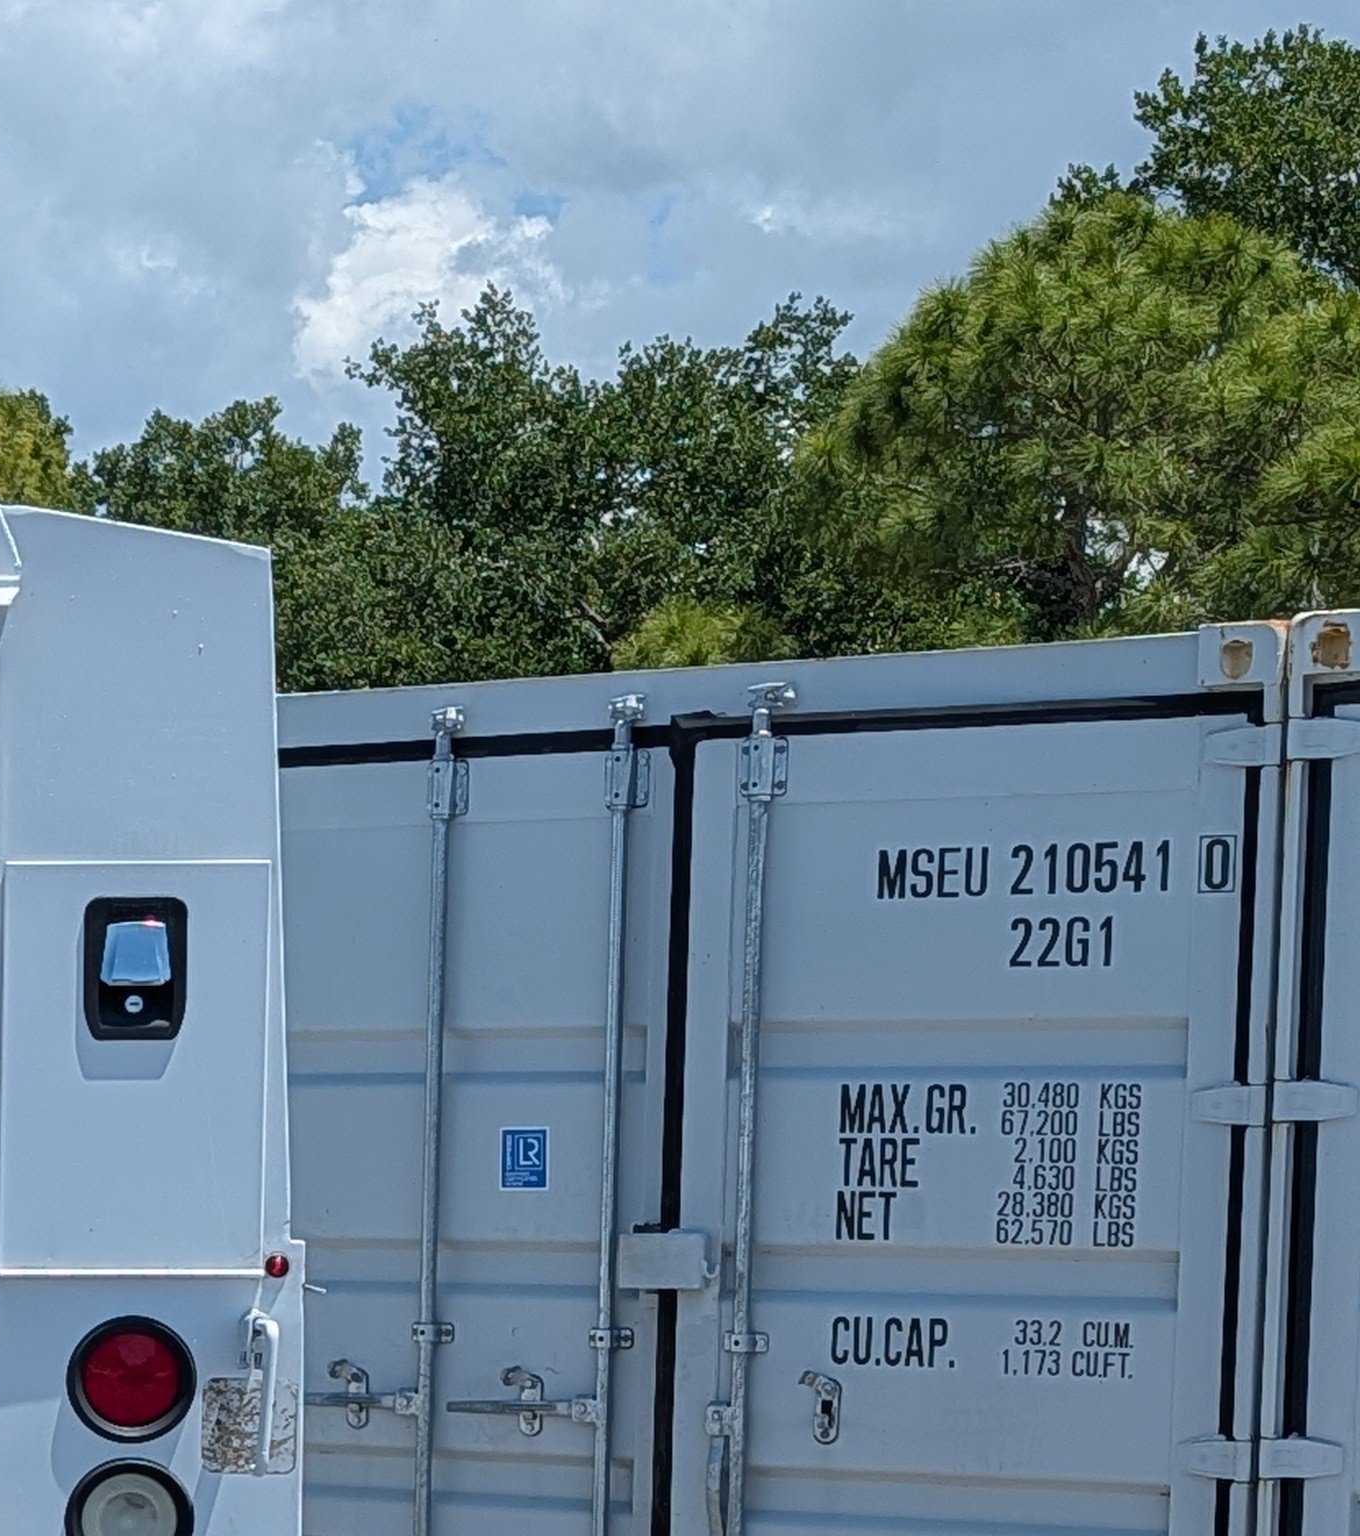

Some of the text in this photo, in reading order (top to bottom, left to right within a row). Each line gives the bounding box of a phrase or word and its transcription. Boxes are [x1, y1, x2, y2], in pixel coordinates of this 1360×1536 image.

[877, 839, 1230, 899] MSEU 210541 0
[1010, 916, 1113, 967] 22G1
[839, 1084, 975, 1134] MAX.GR.
[1100, 1083, 1141, 1109] KGS
[1099, 1112, 1139, 1139] LBS
[519, 1138, 540, 1165] LR
[839, 1138, 920, 1187] TARE
[1097, 1138, 1138, 1165] KGS
[1095, 1167, 1136, 1192] LBS
[836, 1191, 897, 1240] NET
[1094, 1194, 1135, 1220] KGS
[1093, 1221, 1134, 1247] LBS
[831, 1317, 1133, 1368] CU.CAP. 33.2 CU.M.
[1072, 1351, 1133, 1379] CU.FT.
